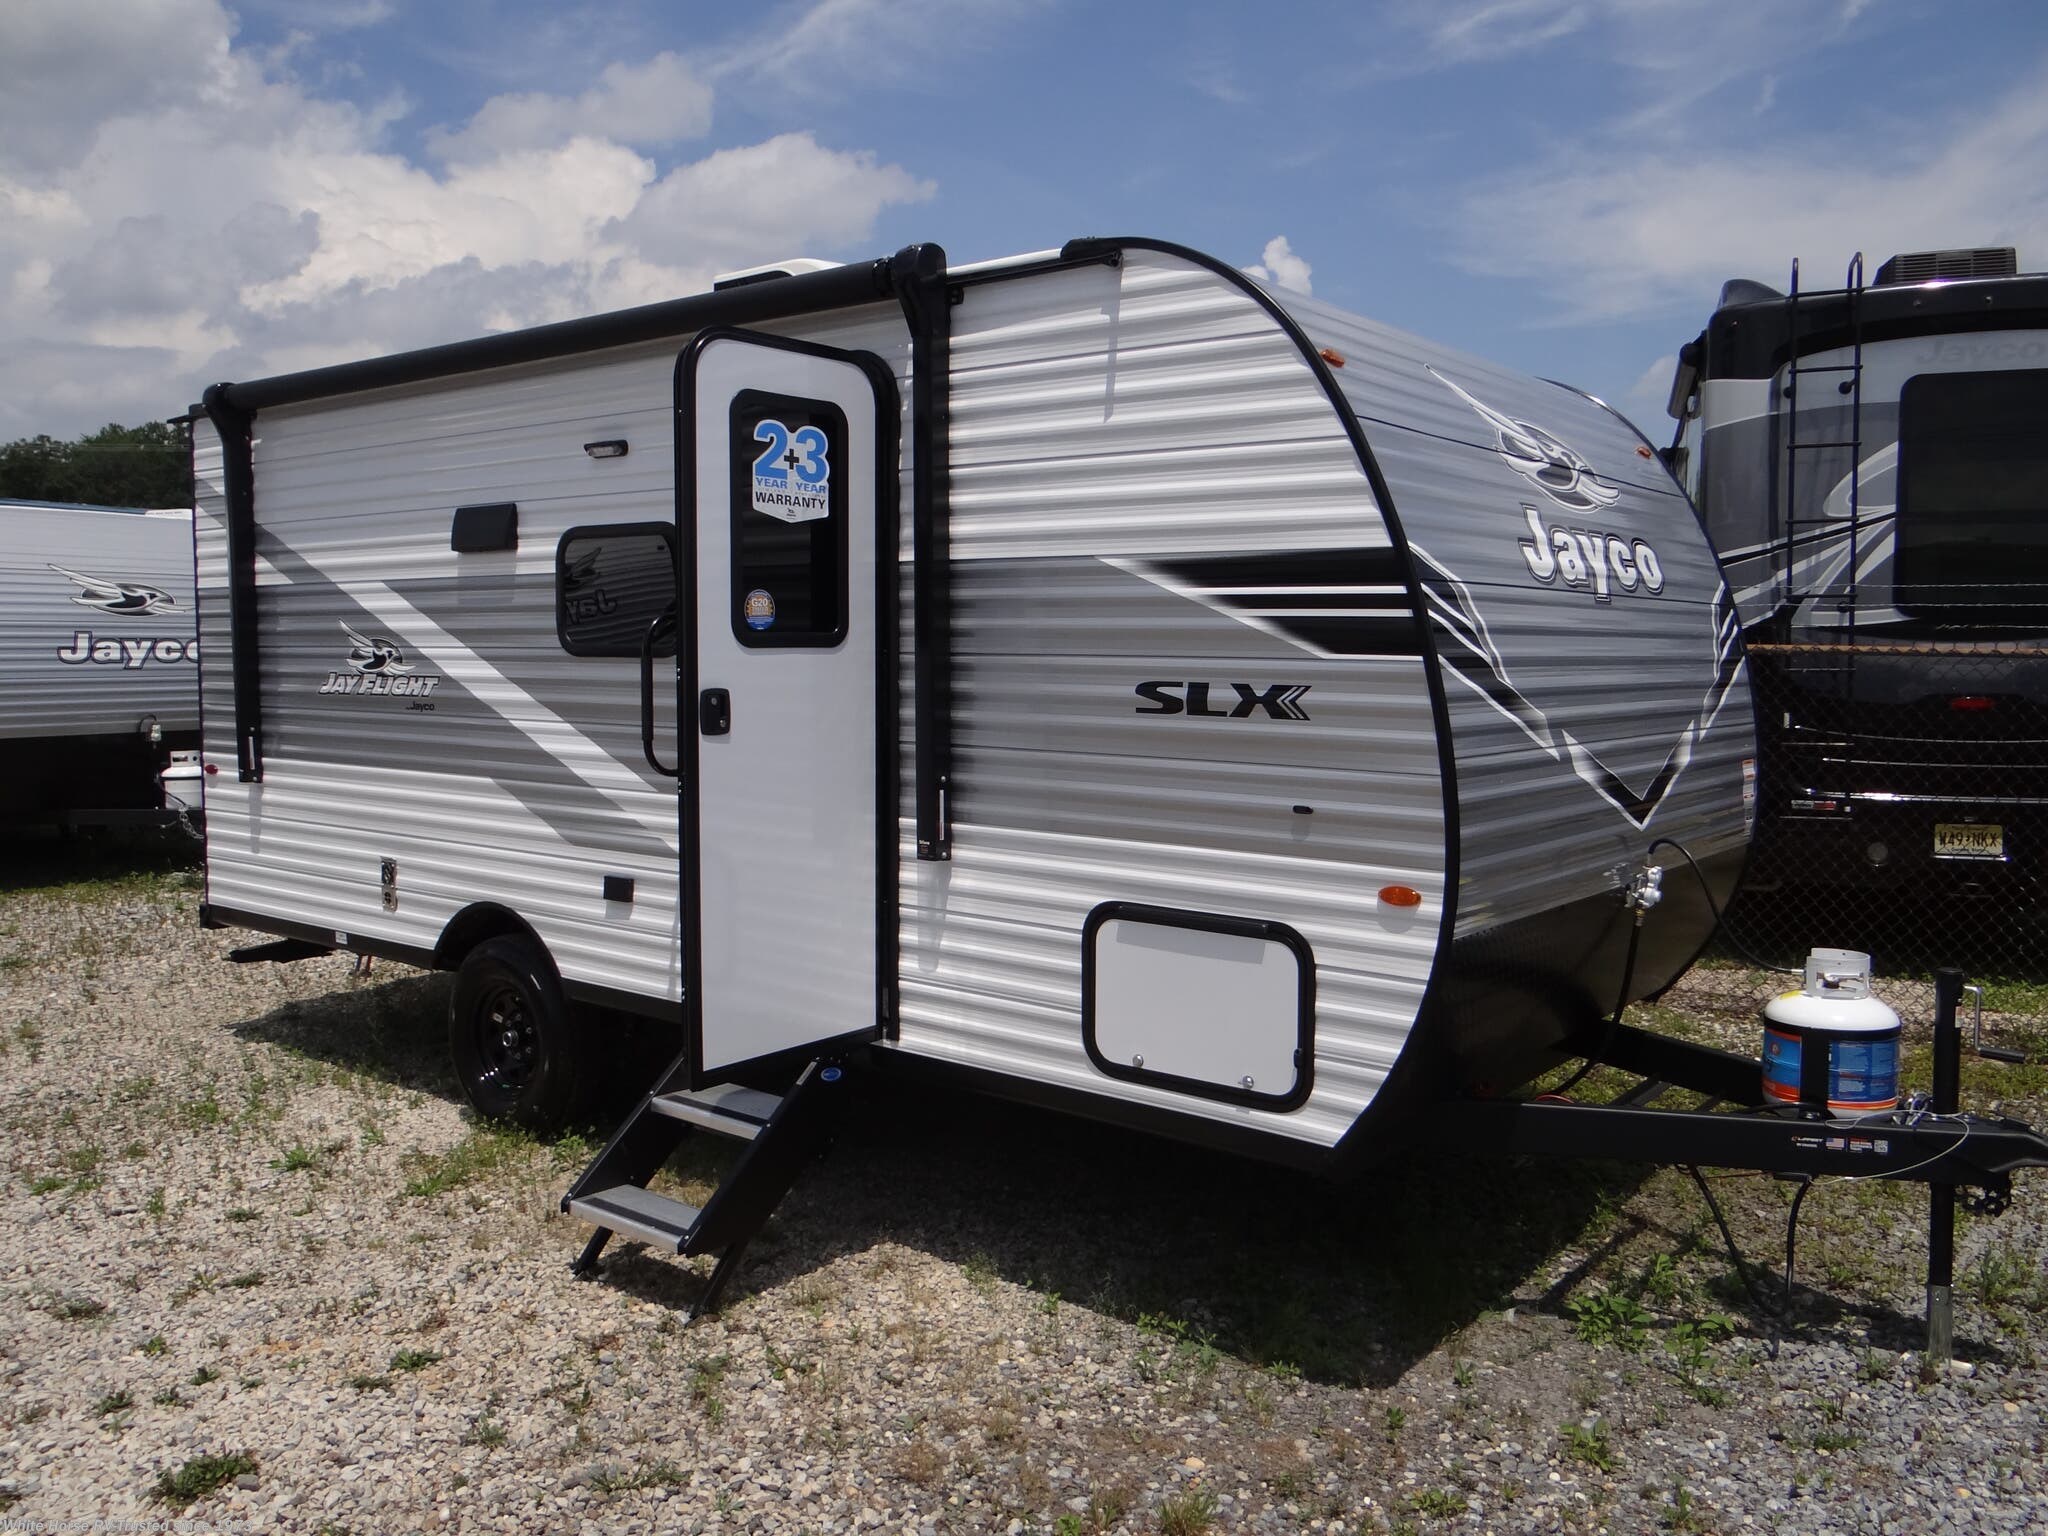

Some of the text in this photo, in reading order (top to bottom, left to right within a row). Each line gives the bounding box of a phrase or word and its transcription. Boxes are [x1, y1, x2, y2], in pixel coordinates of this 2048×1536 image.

[1915, 339, 2046, 367] Jayco
[755, 477, 788, 489] YEAR
[796, 482, 827, 494] YEAR
[755, 492, 826, 510] WARRANTY
[1517, 501, 1665, 604] Jayco
[319, 672, 440, 697] JAY FLIGHT
[1135, 680, 1312, 721] SLX
